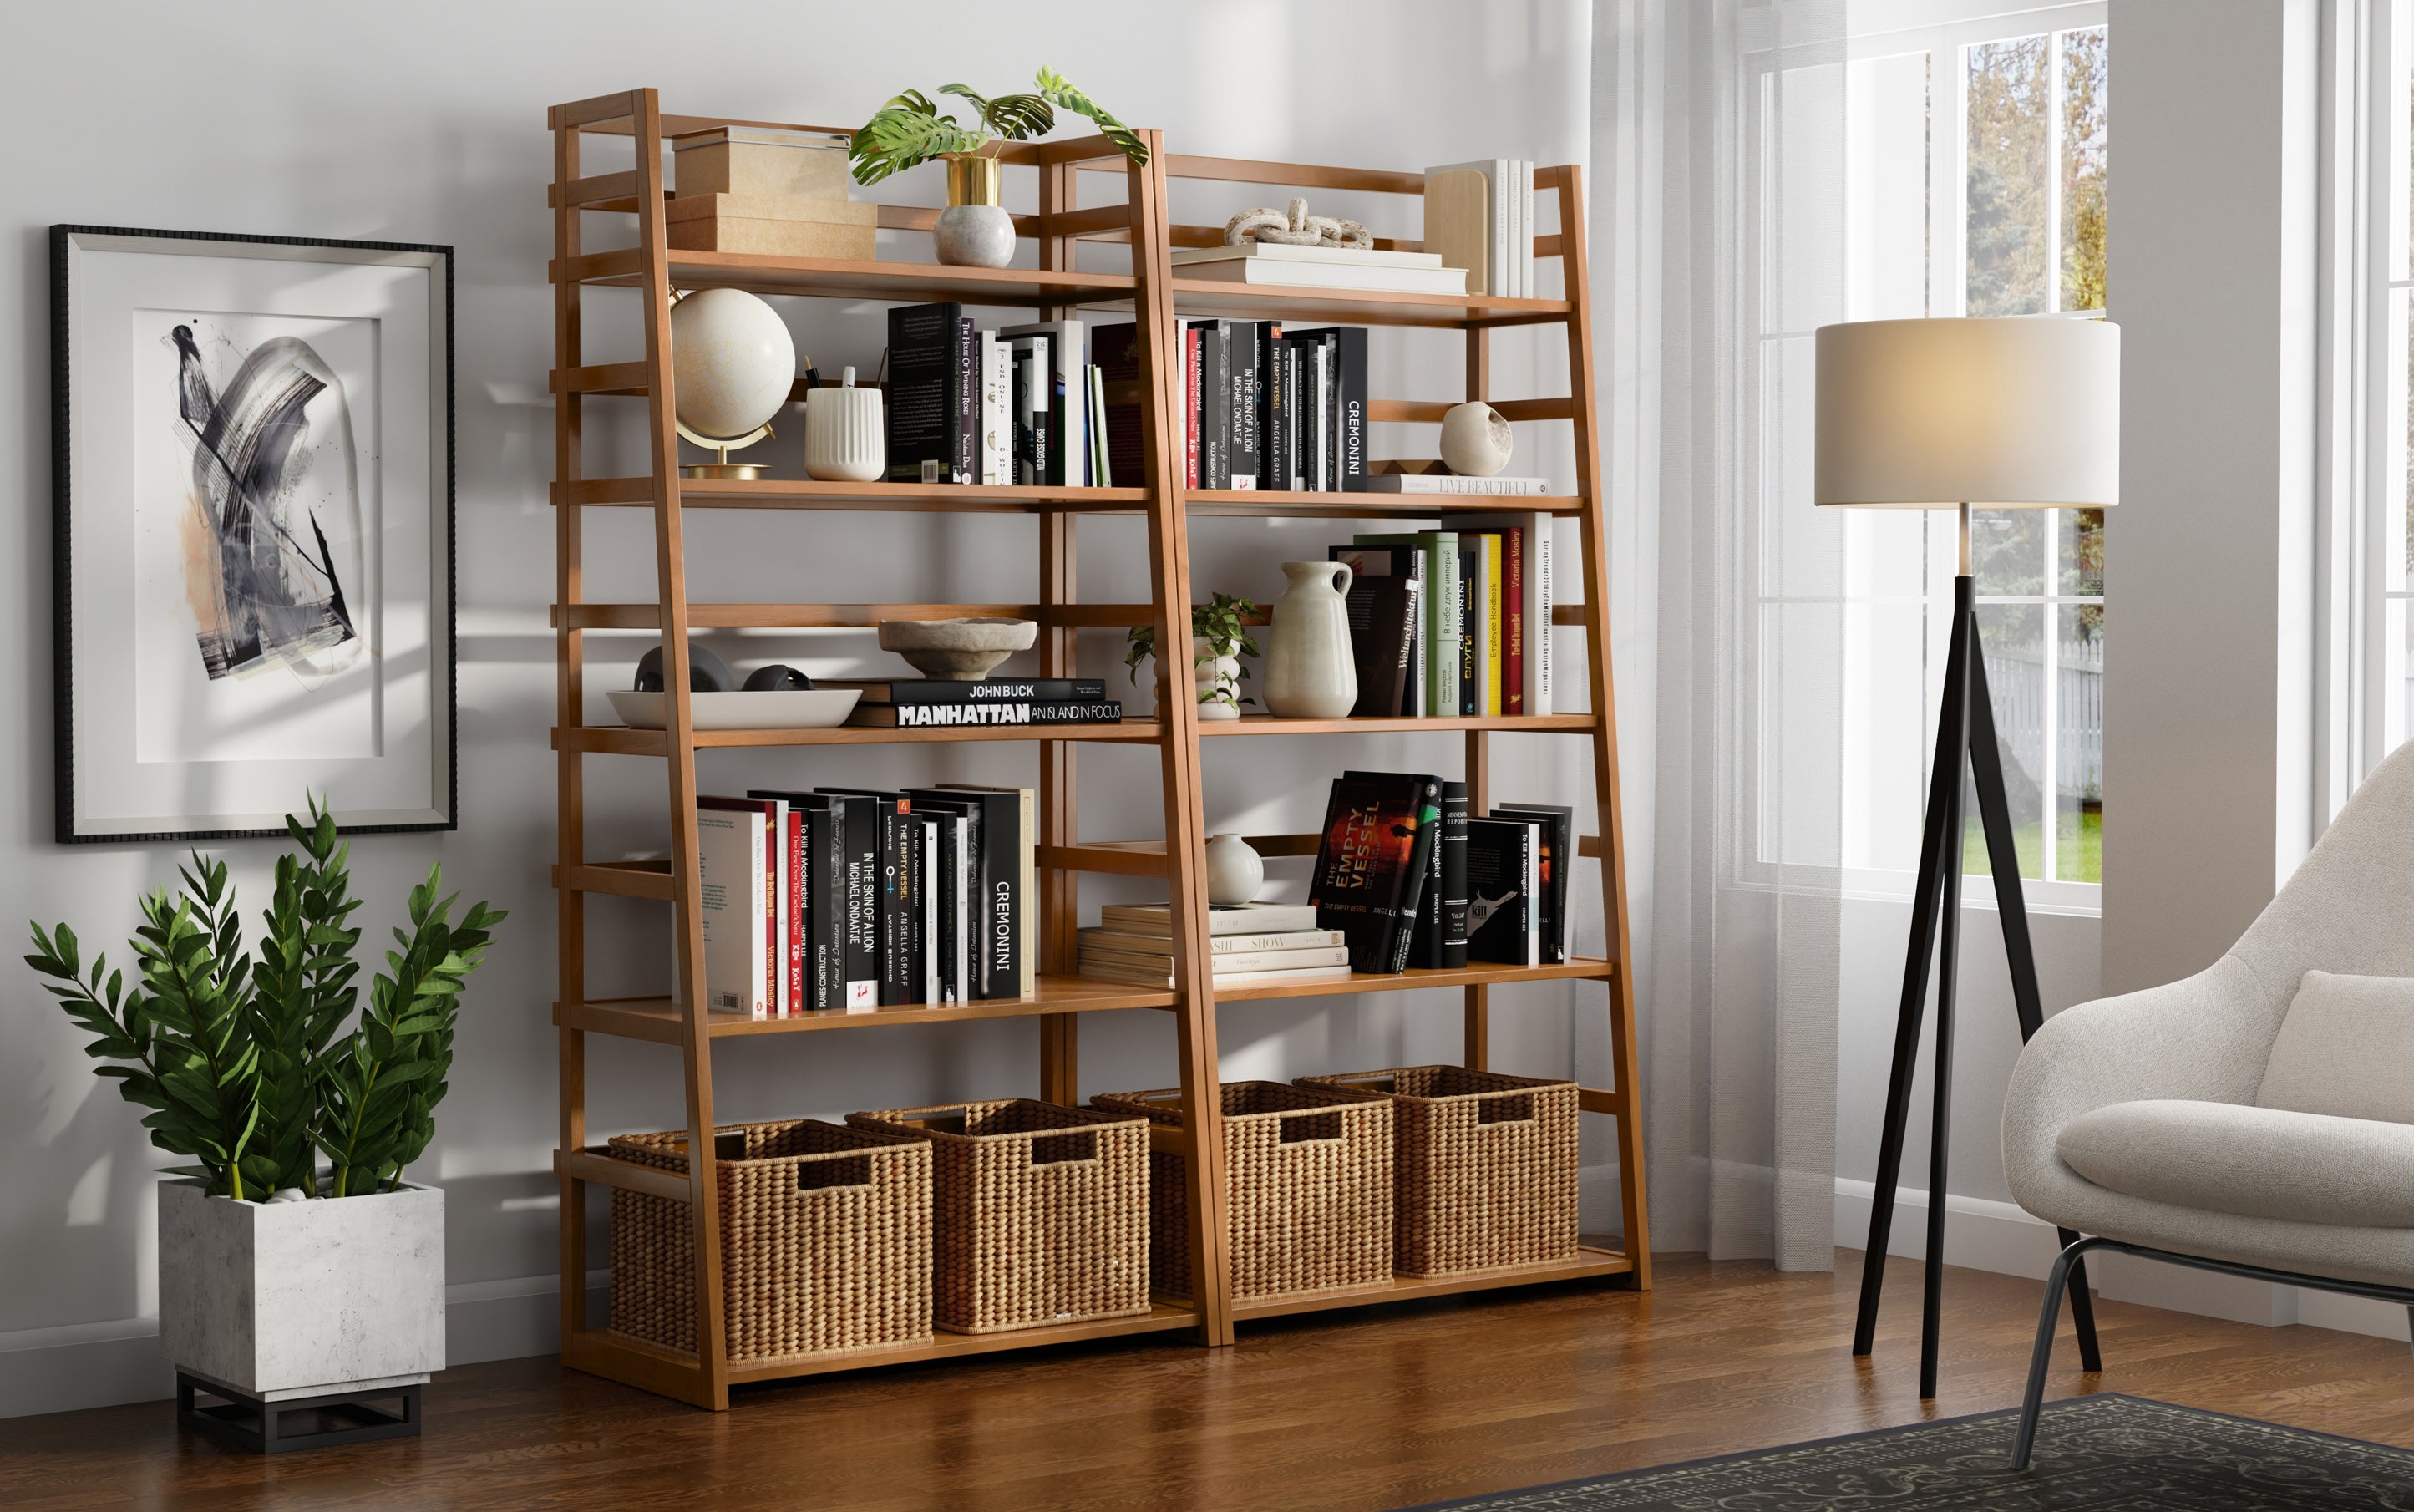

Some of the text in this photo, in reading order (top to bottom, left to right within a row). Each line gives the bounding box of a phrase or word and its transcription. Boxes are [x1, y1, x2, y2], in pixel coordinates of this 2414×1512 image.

[1196, 341, 1202, 349] To
[1284, 351, 1289, 359] To
[1244, 369, 1253, 378] IN
[1244, 378, 1253, 394] THE
[1234, 376, 1242, 444] MICHAEL ONDAATJE
[1244, 395, 1253, 414] SKIN
[1244, 414, 1253, 425] OF
[1244, 434, 1253, 453] LION
[1348, 401, 1360, 475] CREMONINI
[1037, 429, 1045, 470] WILD GOOSE CHASE
[1439, 479, 1465, 494] LIVE
[1468, 480, 1529, 495] BEAUTIFUL
[1443, 550, 1452, 585] империй
[1511, 531, 1521, 588] Victoria Mosley
[1443, 586, 1452, 605] двух
[1443, 606, 1452, 627] небе
[1398, 589, 1418, 668] Weltarchitektur
[1512, 613, 1521, 656] The Red Dragon Bed
[969, 685, 1034, 698] JOHN BUCK
[898, 703, 1120, 725] MANHATTAN AN ISLAND IN FOCUS
[801, 824, 809, 834] To
[913, 828, 920, 837] To
[1336, 807, 1363, 888] EMPTY
[1350, 801, 1380, 888] VESSEL
[1433, 830, 1441, 878] Mockingbird
[863, 852, 875, 862] IN
[863, 864, 875, 881] THE
[1326, 863, 1337, 886] THE
[849, 862, 860, 945] MICHAEL ONDAATJE
[863, 884, 875, 906] SKIN
[863, 908, 875, 921] OF
[1351, 905, 1367, 913] VESSEL
[1472, 905, 1487, 917] kill
[997, 881, 1010, 971] CREMONINI
[863, 931, 875, 953] LION
[1251, 936, 1286, 948] SHOW
[833, 968, 841, 990] House
